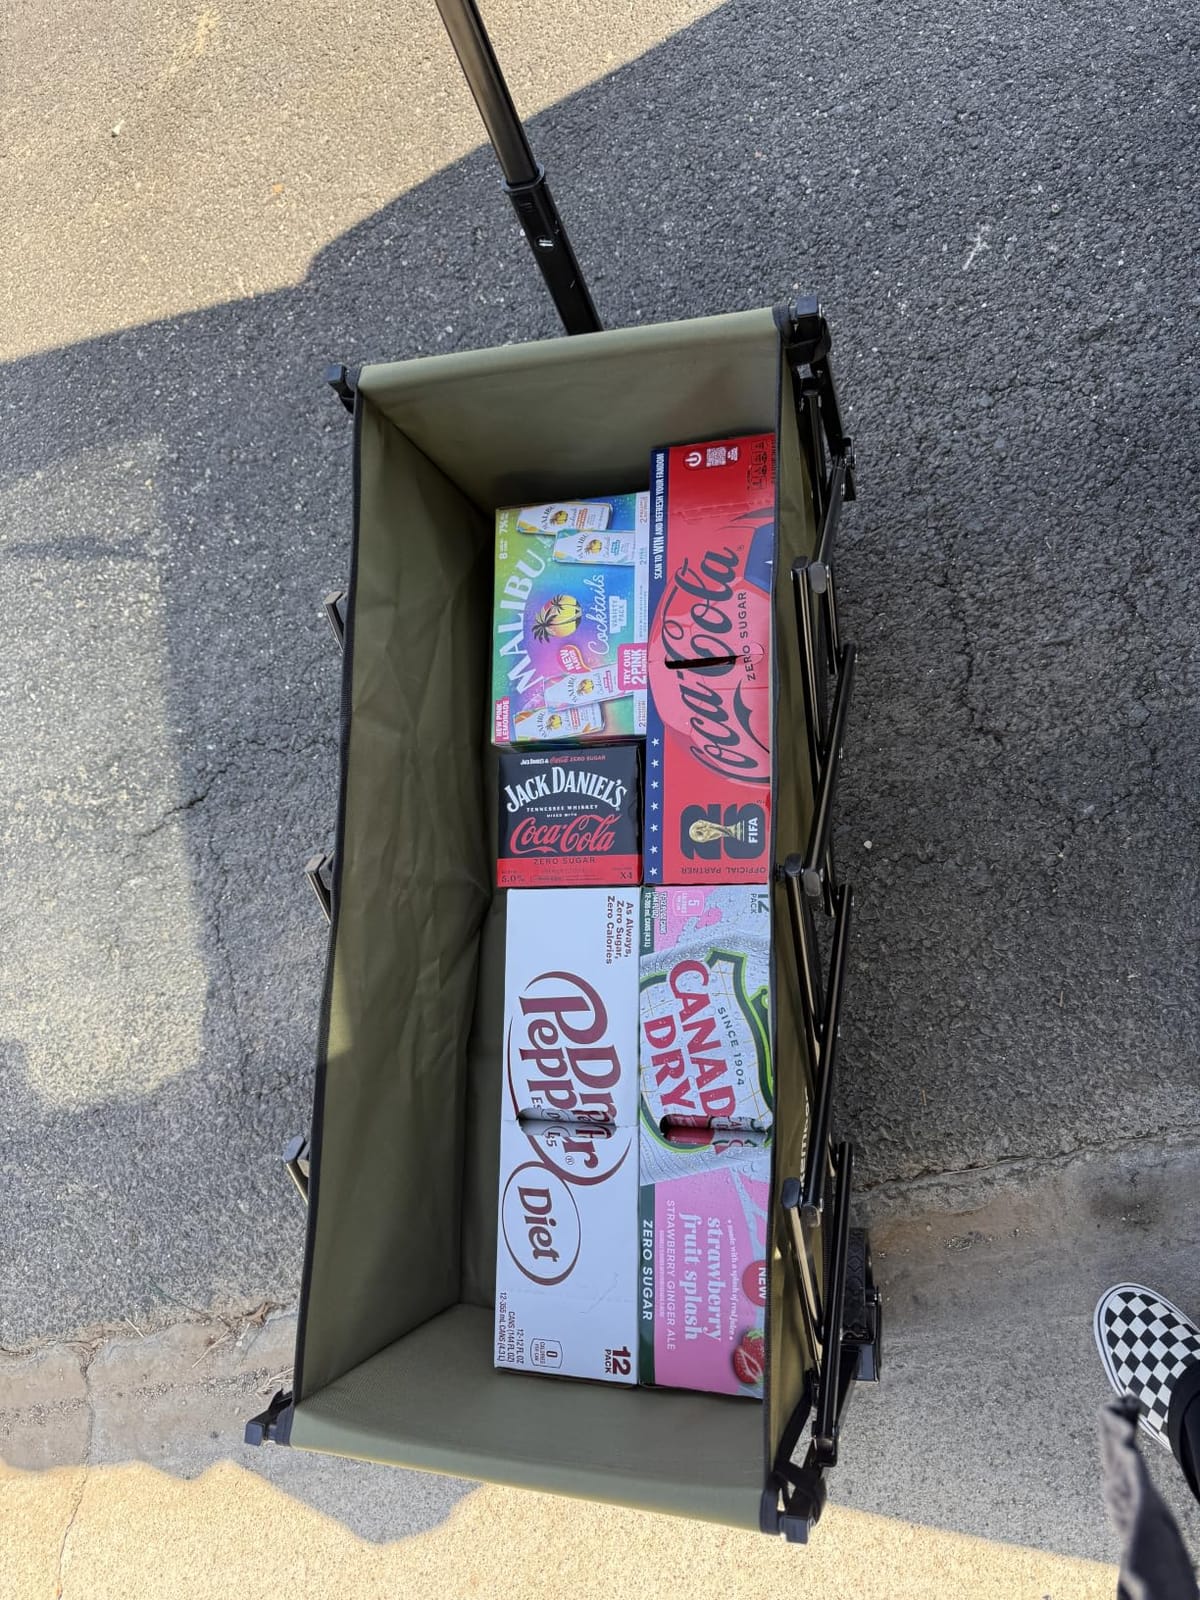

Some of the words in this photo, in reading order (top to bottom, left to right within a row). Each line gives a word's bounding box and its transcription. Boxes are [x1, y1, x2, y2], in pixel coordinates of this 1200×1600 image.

[656, 453, 664, 478] FANDOM
[656, 479, 664, 495] YOUR
[656, 496, 664, 521] REFRESH
[653, 536, 664, 554] WIN
[655, 555, 662, 563] TO
[654, 563, 662, 579] SCAN
[498, 550, 546, 694] MALIBU
[584, 574, 610, 655] Cocktails
[737, 591, 748, 639] SUGAR
[560, 649, 574, 670] NEW
[631, 649, 642, 674] PINK
[661, 547, 770, 783] Coca-Cola
[742, 645, 756, 681] ZERO
[632, 675, 643, 684] 2
[504, 774, 550, 813] JACK
[552, 766, 628, 808] DANIEL'S
[510, 814, 622, 854] Coca-Cola
[748, 817, 758, 843] FIFA
[607, 896, 615, 919] Zero
[616, 900, 624, 924] Zero
[626, 902, 634, 915] As
[606, 922, 615, 965] Calories
[615, 927, 624, 959] Sugar,
[624, 918, 634, 957] Always,
[644, 1015, 696, 1109] DRY
[669, 960, 736, 1155] CANAD
[717, 1007, 739, 1048] SINCE
[732, 1053, 745, 1086] 1904
[518, 971, 608, 1169] Peppr
[565, 1045, 621, 1122] Dr
[517, 1186, 560, 1262] Diet
[643, 1220, 653, 1260] ZERO
[666, 1200, 675, 1277] STRAWBERRY
[679, 1213, 702, 1265] fruit
[730, 1246, 738, 1263] with
[642, 1267, 653, 1320] SUGAR
[703, 1217, 726, 1341] strawberry
[730, 1270, 738, 1293] splash
[758, 1267, 766, 1299] NEW
[499, 1292, 507, 1313] 12-355
[667, 1280, 676, 1325] GINGER
[679, 1270, 703, 1340] splash
[499, 1314, 506, 1324] mL
[507, 1344, 514, 1352] FL
[516, 1329, 524, 1347] 12-12
[667, 1329, 675, 1350] ALE
[516, 1355, 524, 1364] OZ
[612, 1346, 631, 1375] 12
